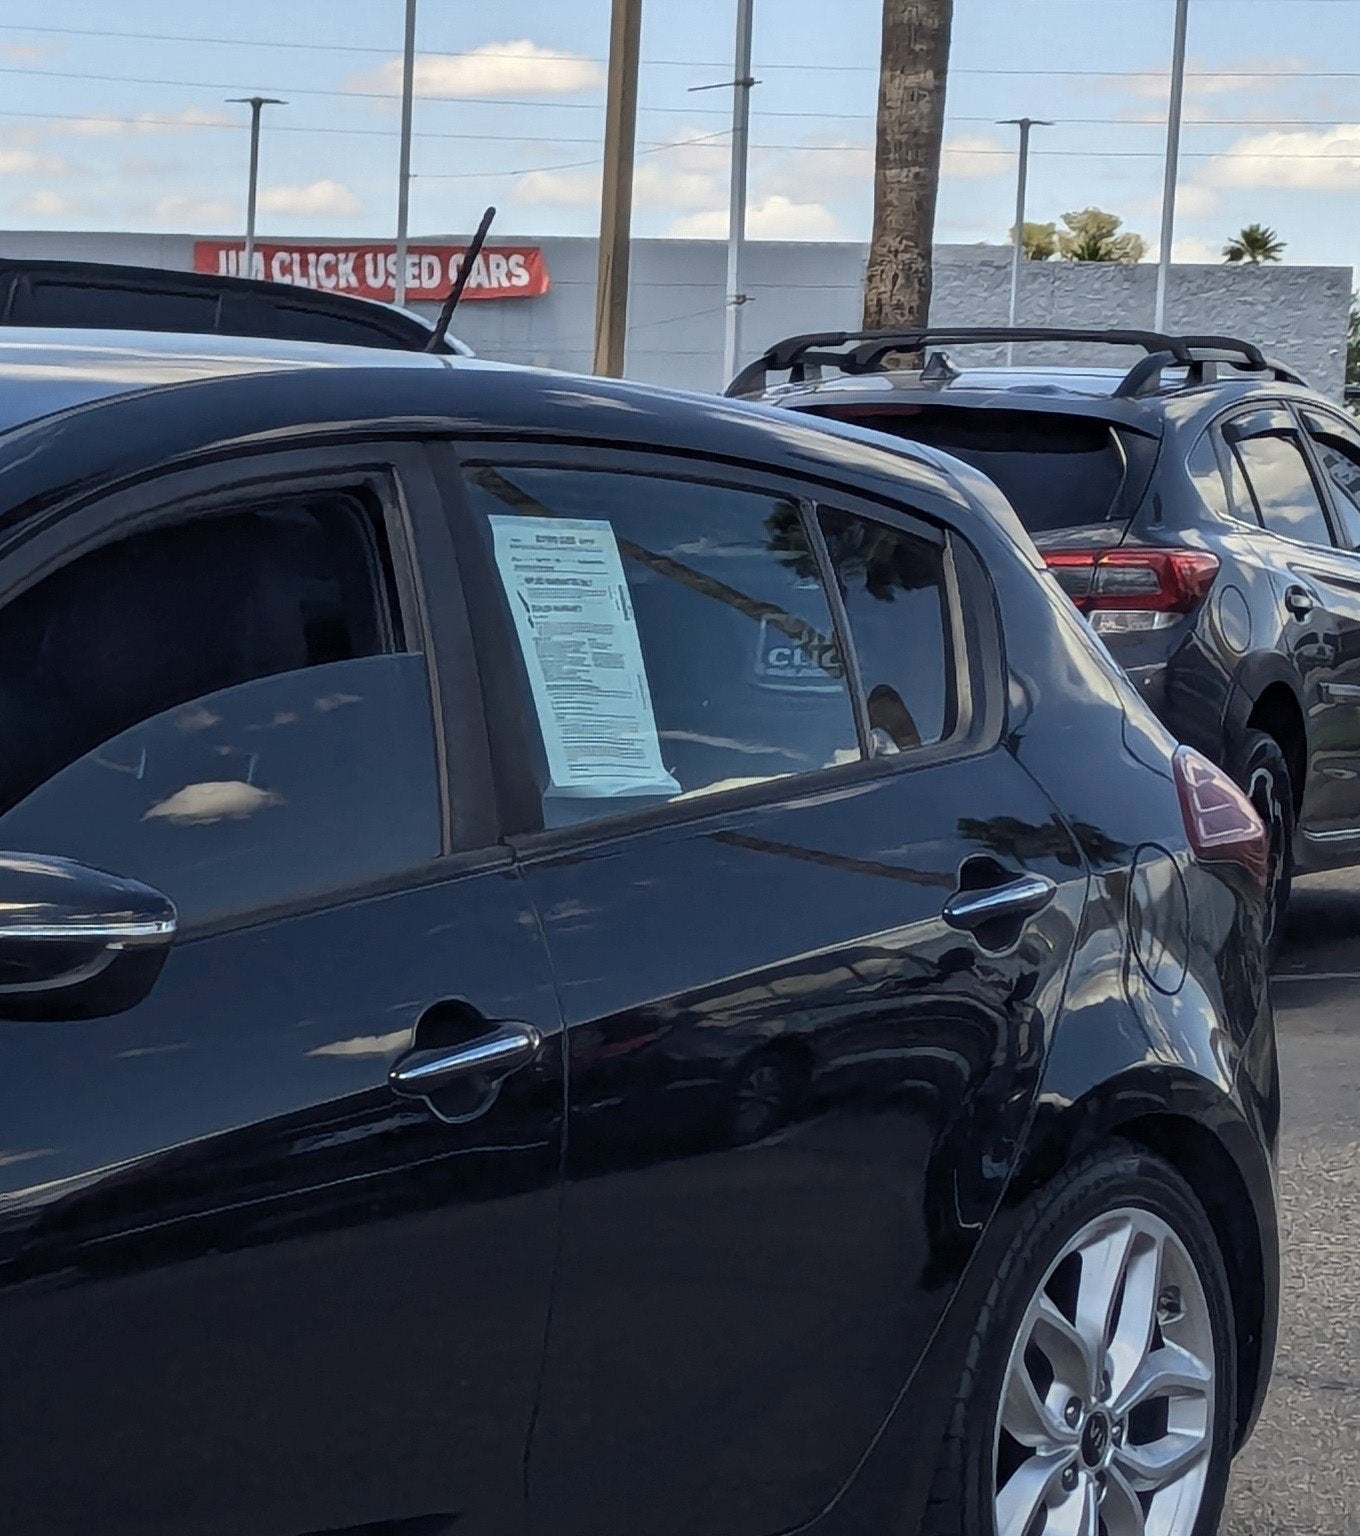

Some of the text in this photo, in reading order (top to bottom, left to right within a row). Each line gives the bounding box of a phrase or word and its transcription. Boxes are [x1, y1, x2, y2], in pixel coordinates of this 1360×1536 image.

[271, 251, 362, 291] CLICK
[365, 252, 442, 290] USED
[447, 253, 530, 289] CARS
